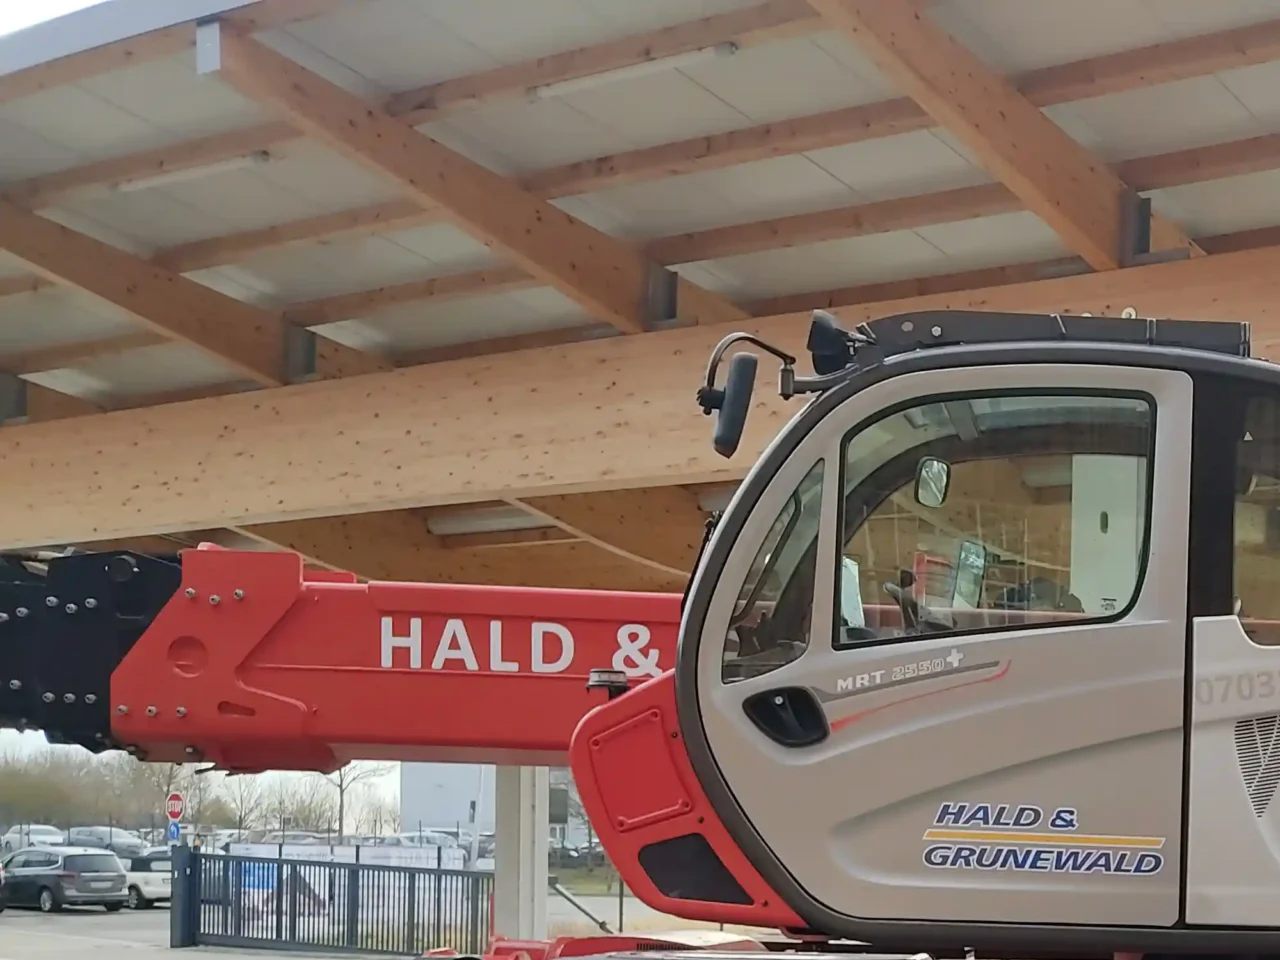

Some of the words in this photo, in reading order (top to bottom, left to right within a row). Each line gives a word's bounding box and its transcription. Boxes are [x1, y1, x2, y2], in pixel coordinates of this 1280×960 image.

[381, 616, 575, 674] HALD
[611, 623, 663, 678] &
[836, 670, 886, 692] MRT
[168, 800, 183, 812] STOP
[934, 803, 1043, 828] HALD
[1049, 808, 1079, 830] &
[923, 844, 1164, 875] GRUNEWALD
